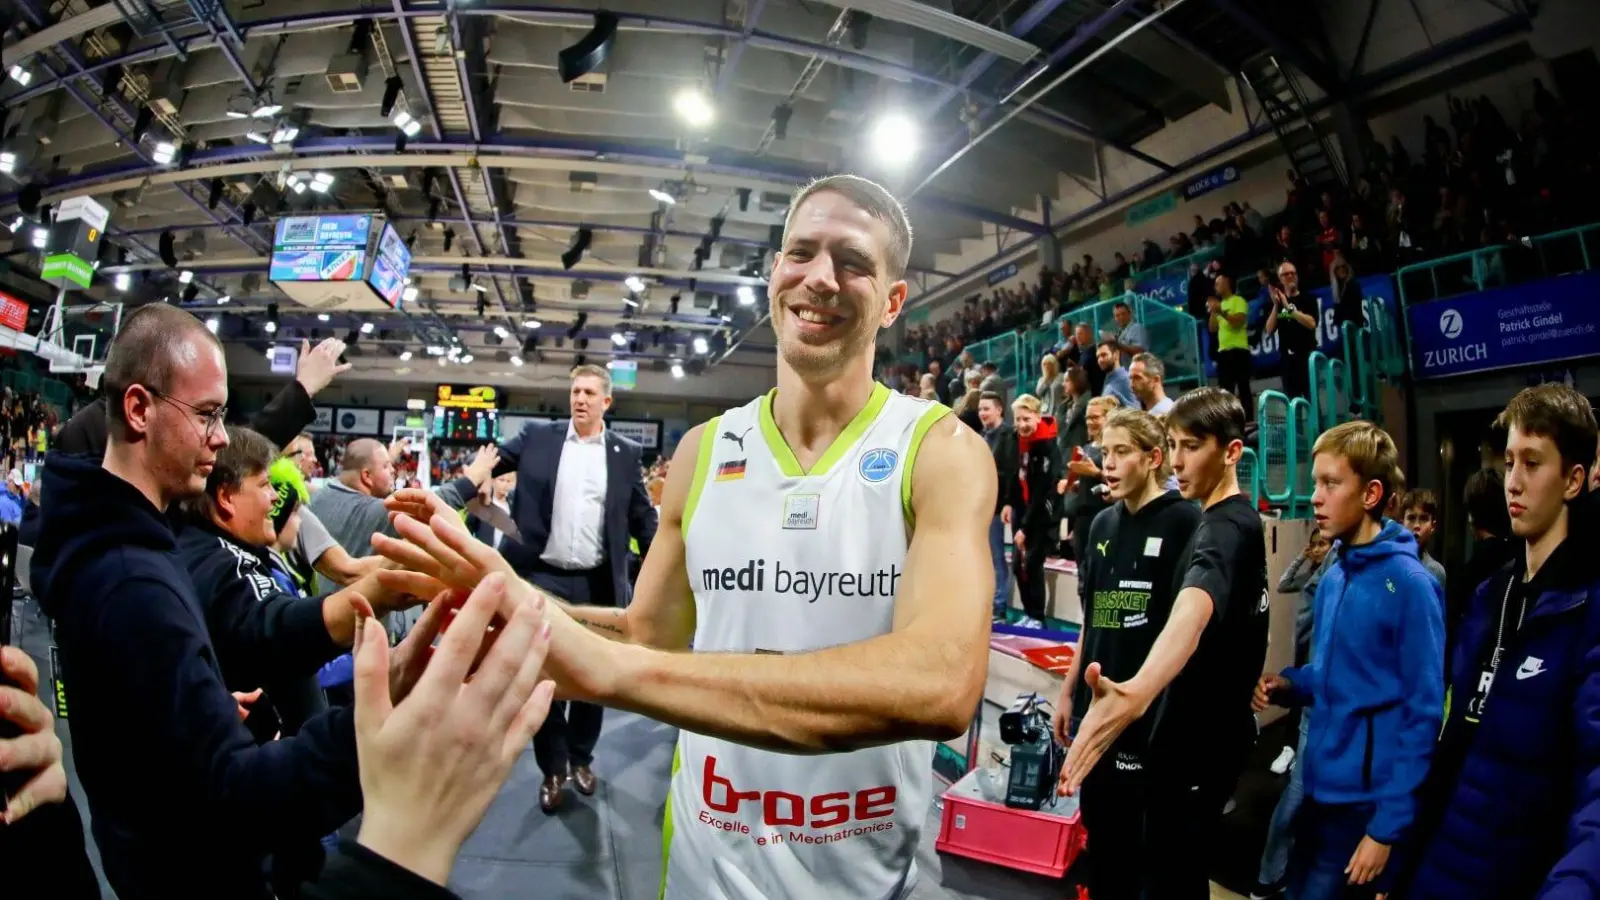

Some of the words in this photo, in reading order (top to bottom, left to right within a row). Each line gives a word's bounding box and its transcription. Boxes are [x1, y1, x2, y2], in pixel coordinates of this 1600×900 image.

[1499, 319, 1531, 333] Patrick
[1532, 312, 1563, 328] Gindel
[1424, 342, 1487, 368] ZURICH
[787, 518, 814, 526] bayreuth
[702, 559, 765, 592] medi
[775, 561, 902, 603] bayreuth
[1093, 590, 1152, 611] BASKET
[1092, 609, 1121, 628] BALL
[702, 755, 896, 829] brose
[699, 810, 767, 846] Excellee
[771, 832, 784, 845] in
[789, 821, 893, 845] Mechatronics
